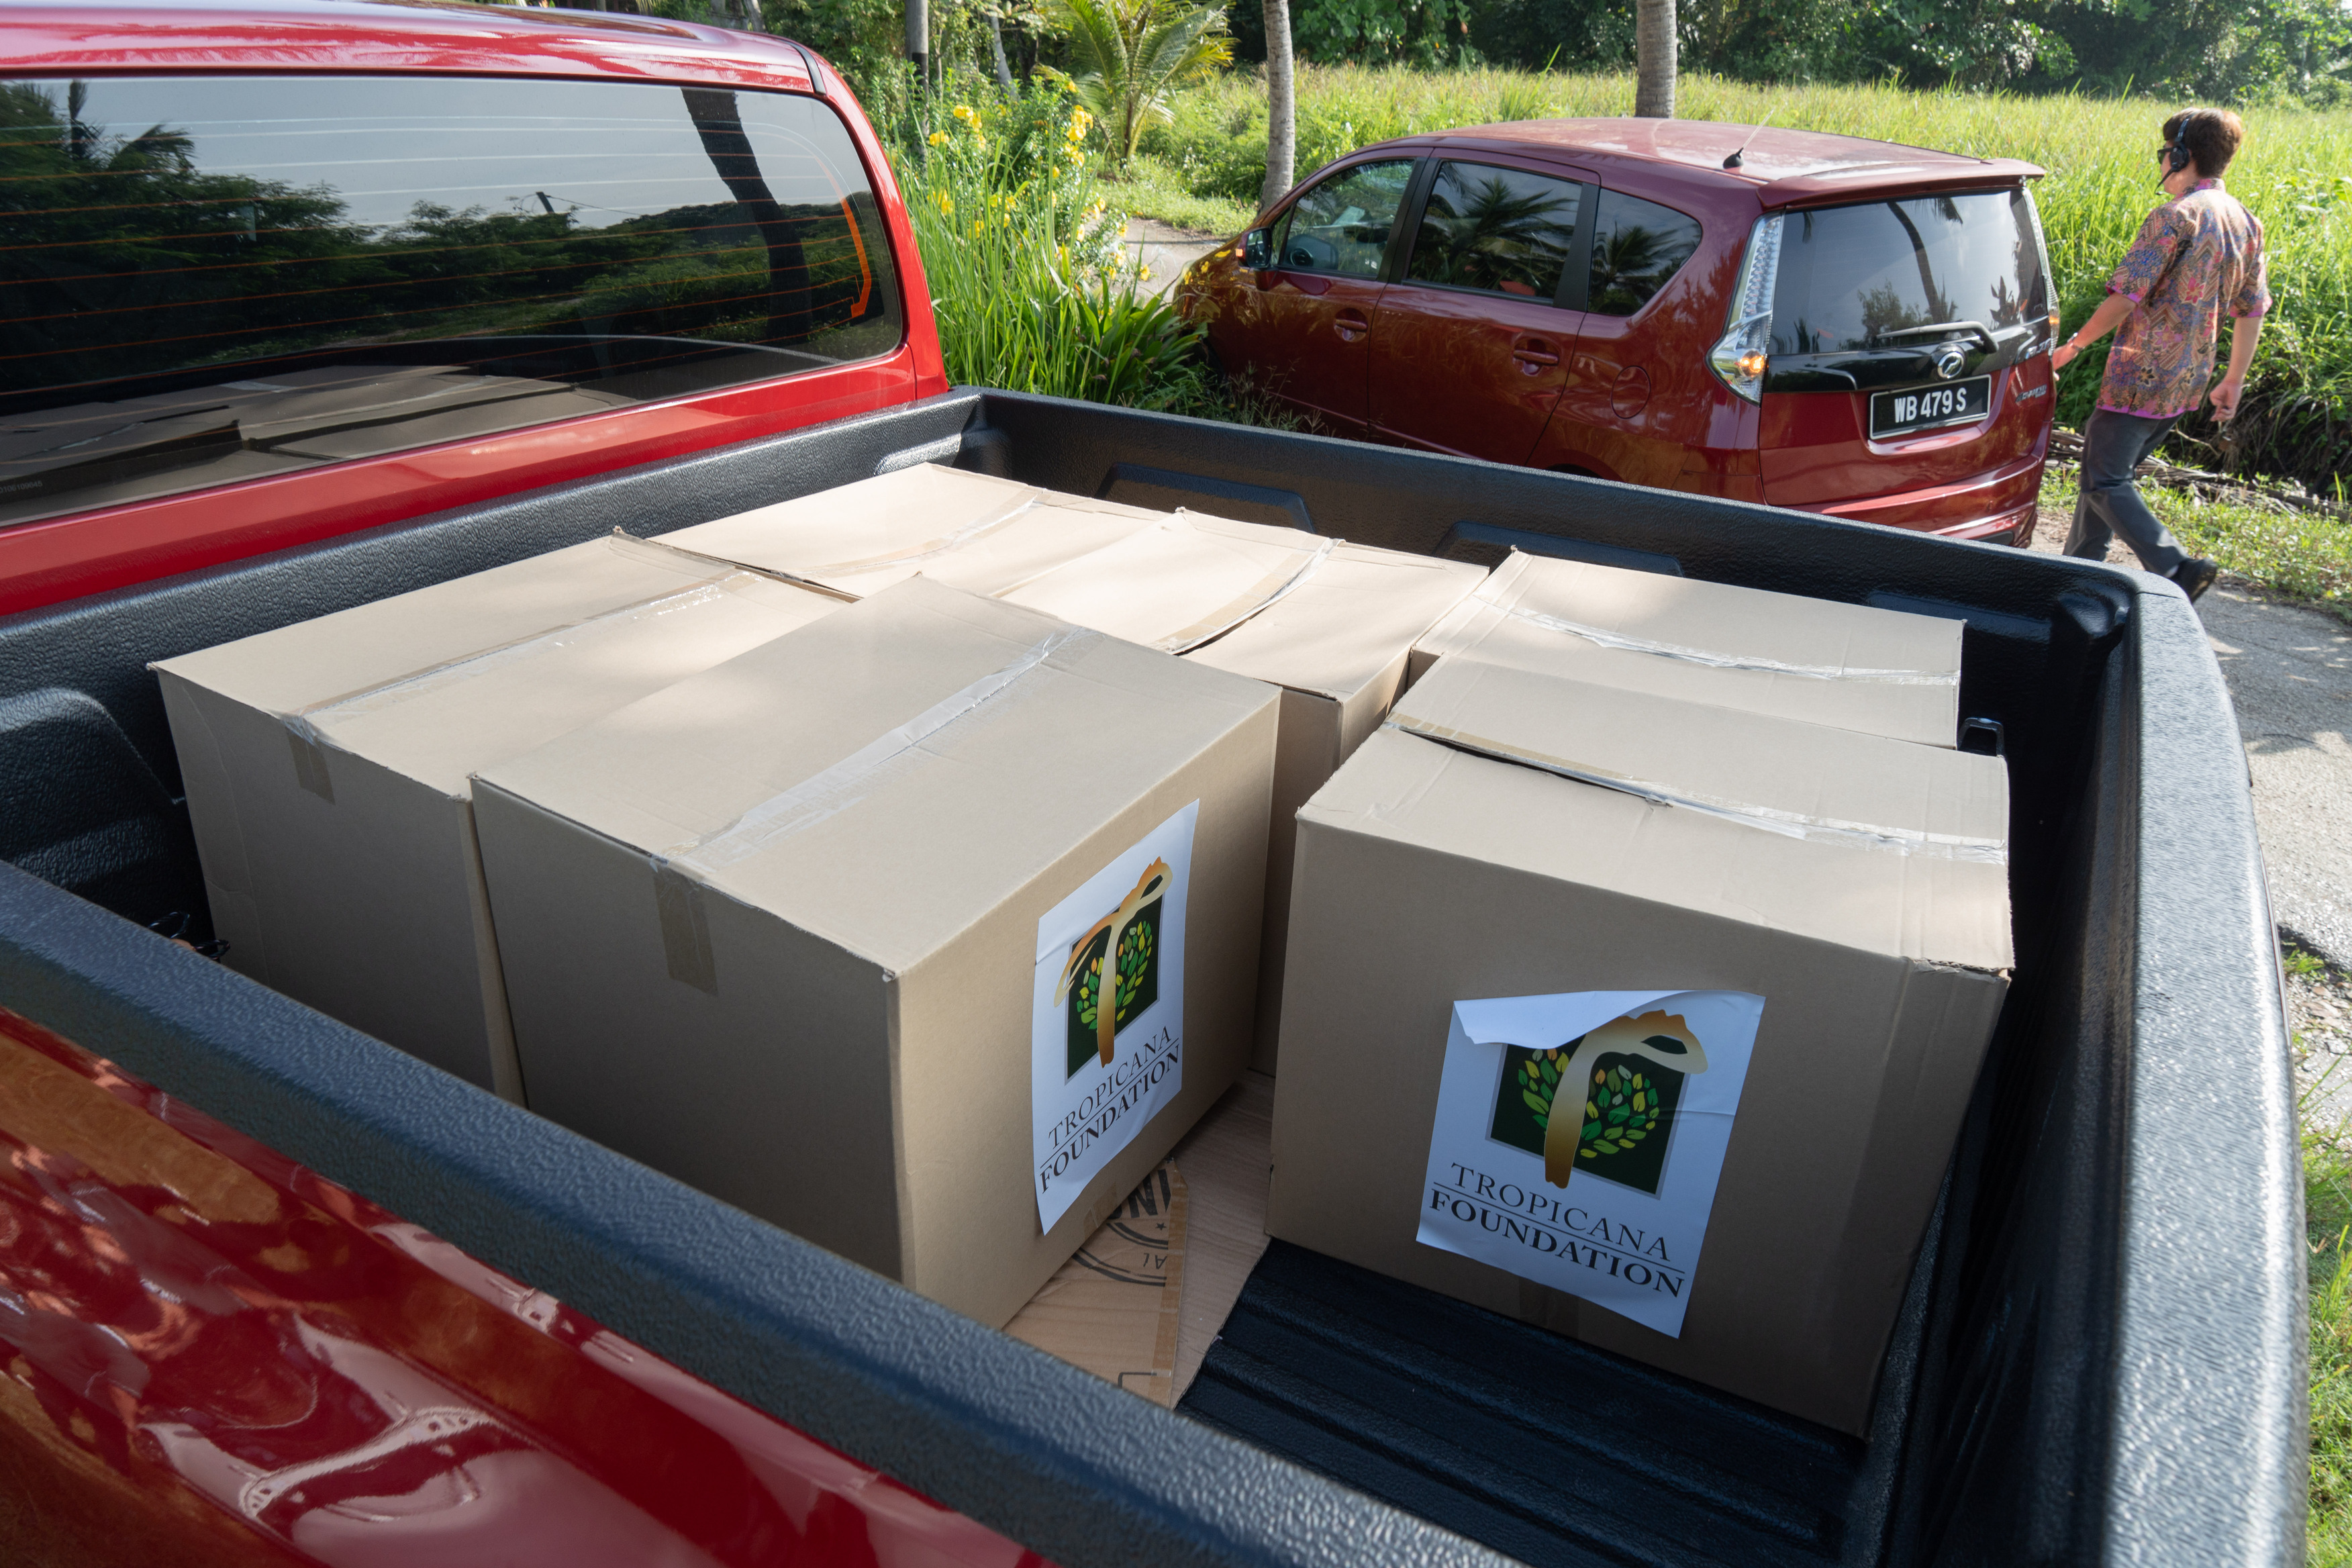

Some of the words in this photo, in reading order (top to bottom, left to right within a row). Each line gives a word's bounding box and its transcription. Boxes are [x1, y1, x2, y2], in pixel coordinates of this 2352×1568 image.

[1894, 396, 1918, 423] WB
[1920, 389, 1953, 418] 479
[1956, 387, 1967, 412] S
[1040, 1044, 1180, 1194] FOUNDATION
[1048, 1026, 1172, 1149] TROPICANA
[1429, 1188, 1685, 1298] FOUNDATION
[1451, 1162, 1671, 1262] TROPICANA
